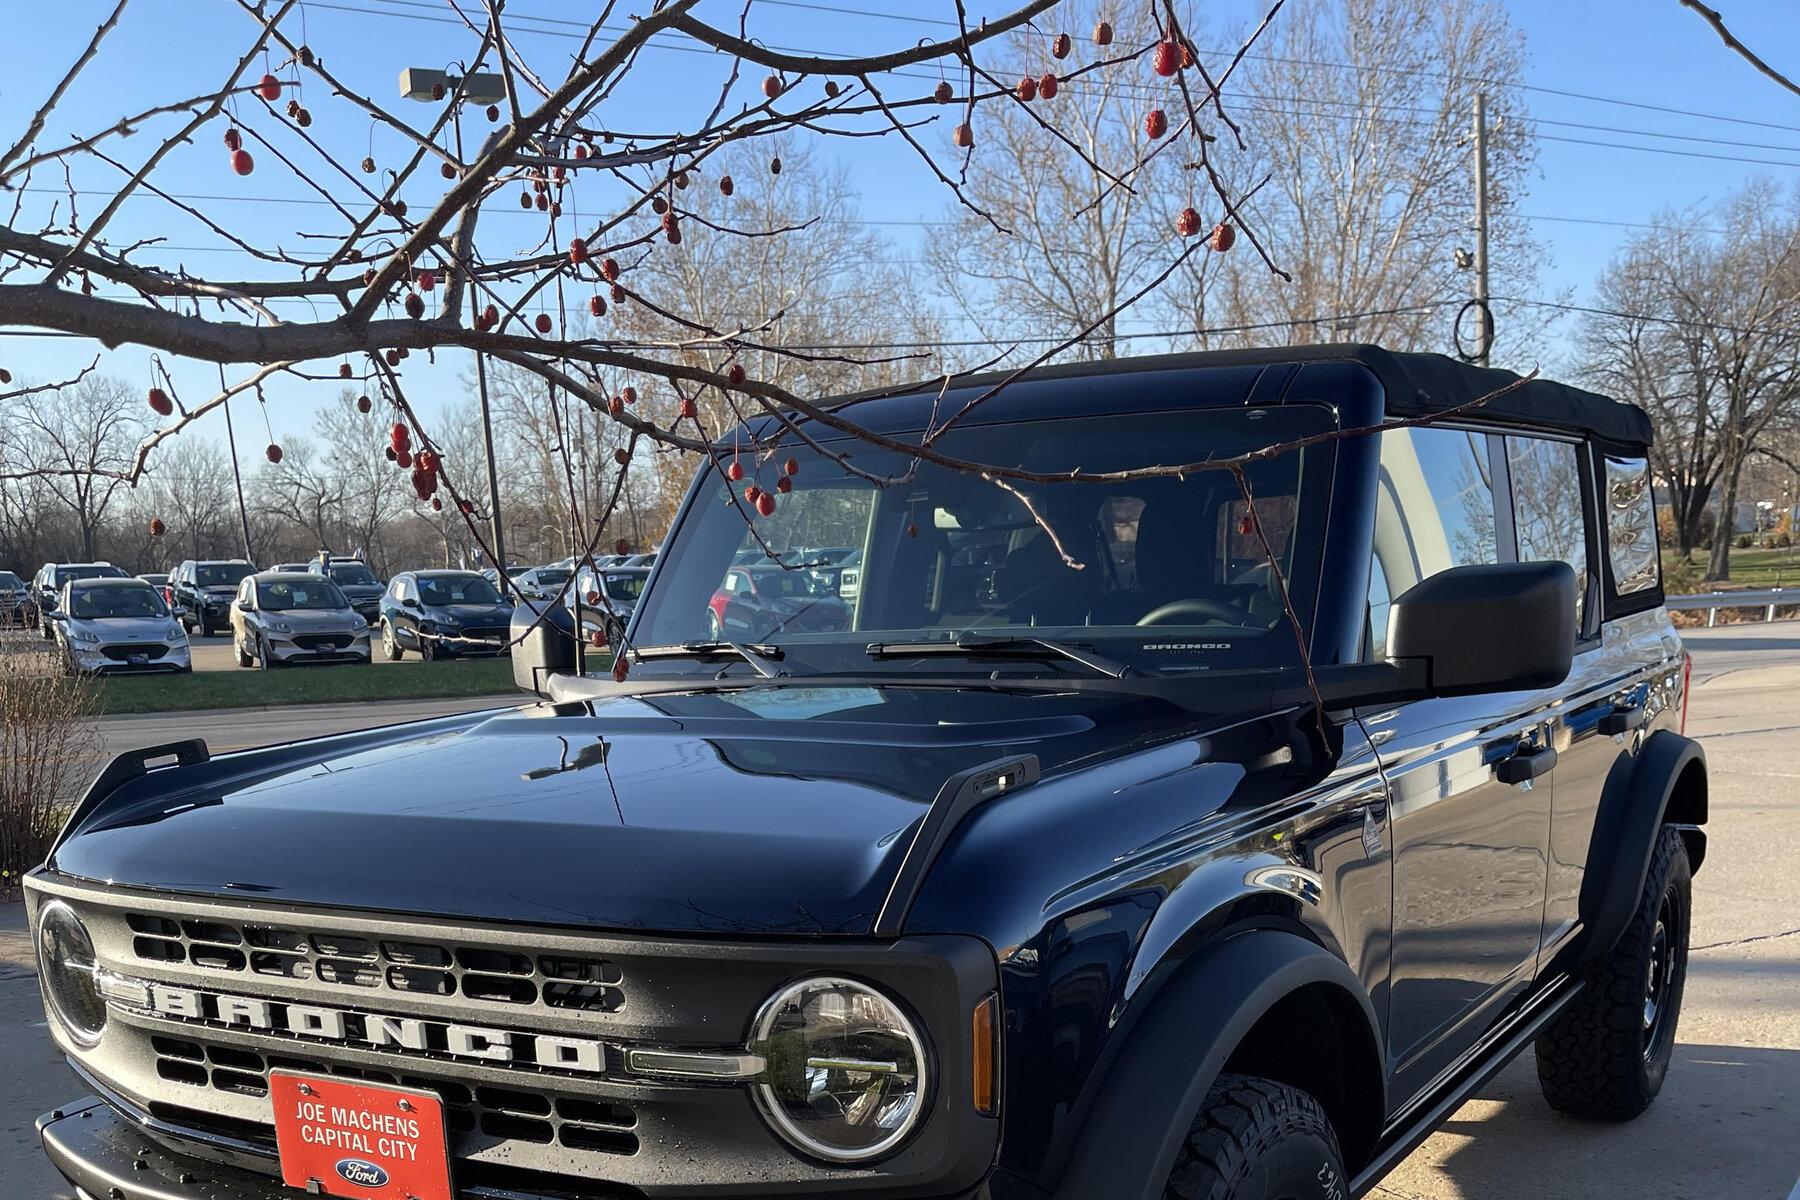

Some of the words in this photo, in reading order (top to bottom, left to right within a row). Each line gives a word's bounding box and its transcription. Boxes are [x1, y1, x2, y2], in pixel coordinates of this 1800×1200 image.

[153, 985, 607, 1072] BRONCO
[296, 1101, 326, 1123] JOE
[332, 1106, 420, 1139] MACHENS
[301, 1125, 374, 1154] CAPITAL
[378, 1138, 418, 1162] CITY
[345, 1161, 379, 1184] Ford
